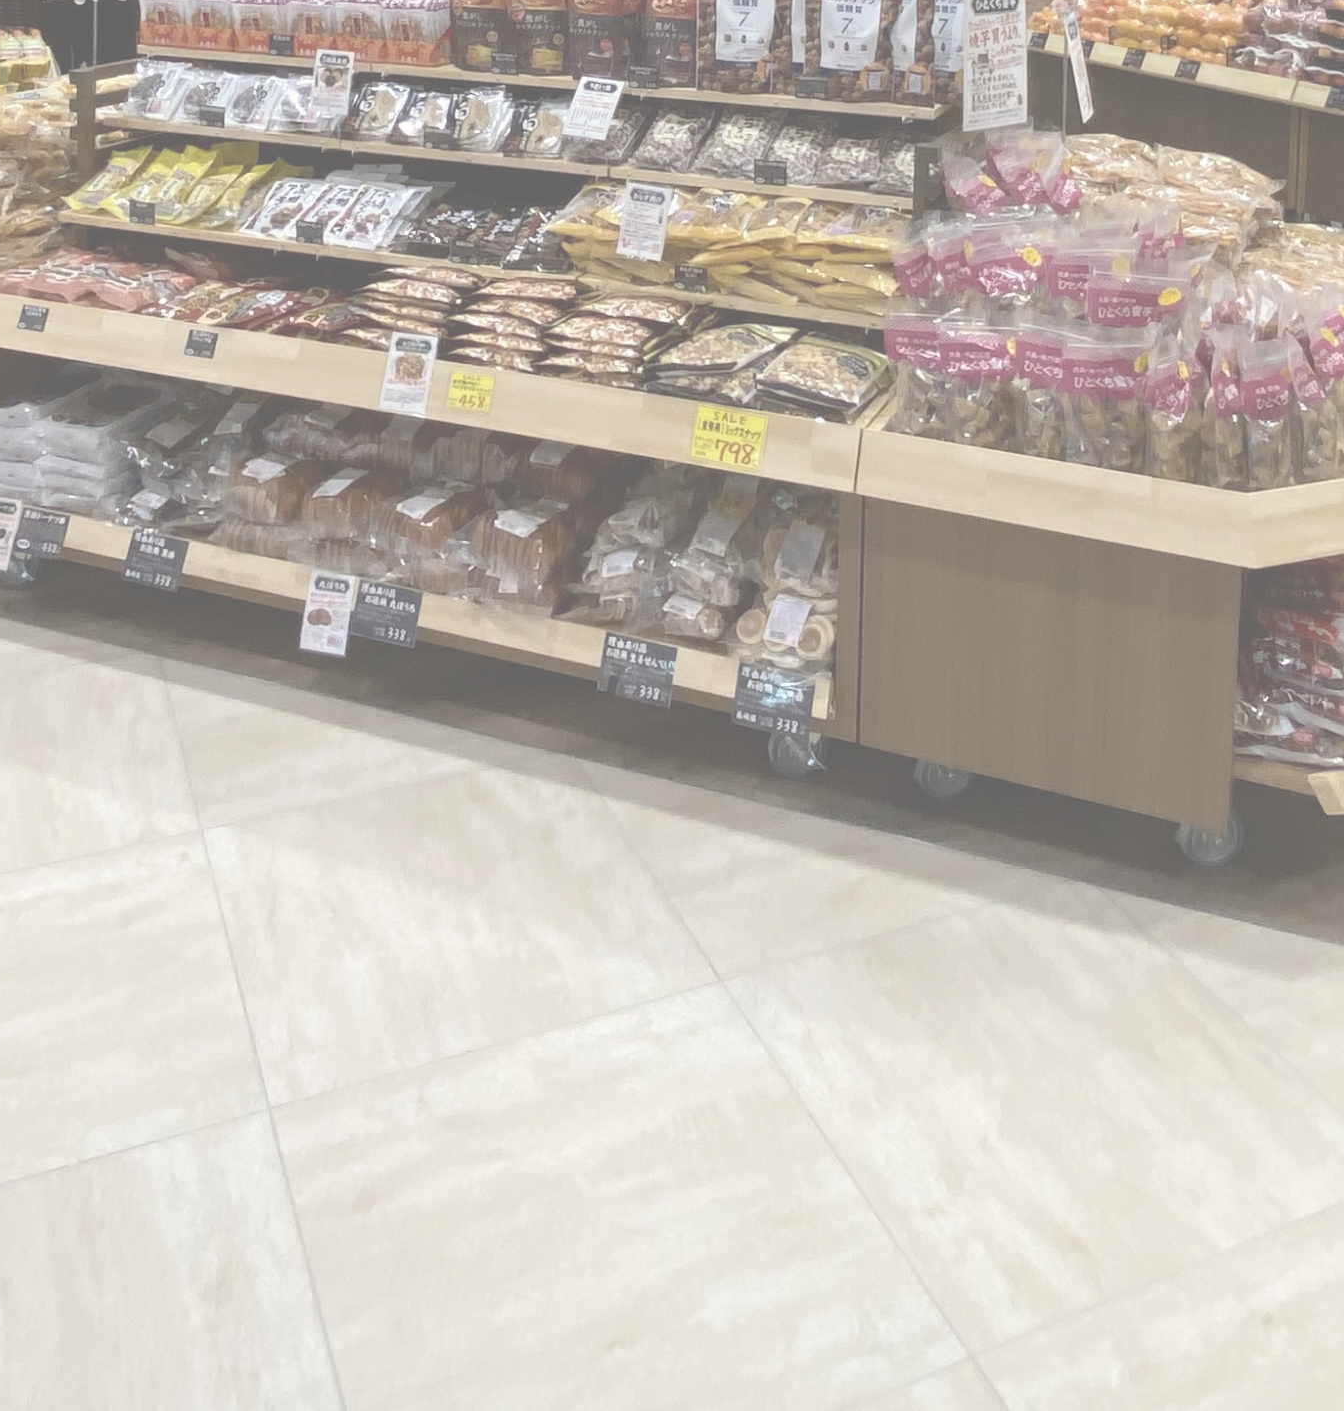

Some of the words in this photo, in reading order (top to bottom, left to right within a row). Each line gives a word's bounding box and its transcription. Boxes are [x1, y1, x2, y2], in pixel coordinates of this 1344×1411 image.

[738, 11, 750, 27] 7
[841, 17, 854, 34] 7
[938, 19, 949, 35] 7
[459, 394, 486, 409] 458
[714, 411, 747, 425] SALE
[716, 439, 755, 465] 798
[388, 627, 406, 641] 338
[639, 685, 660, 701] 338
[776, 717, 799, 734] 338
